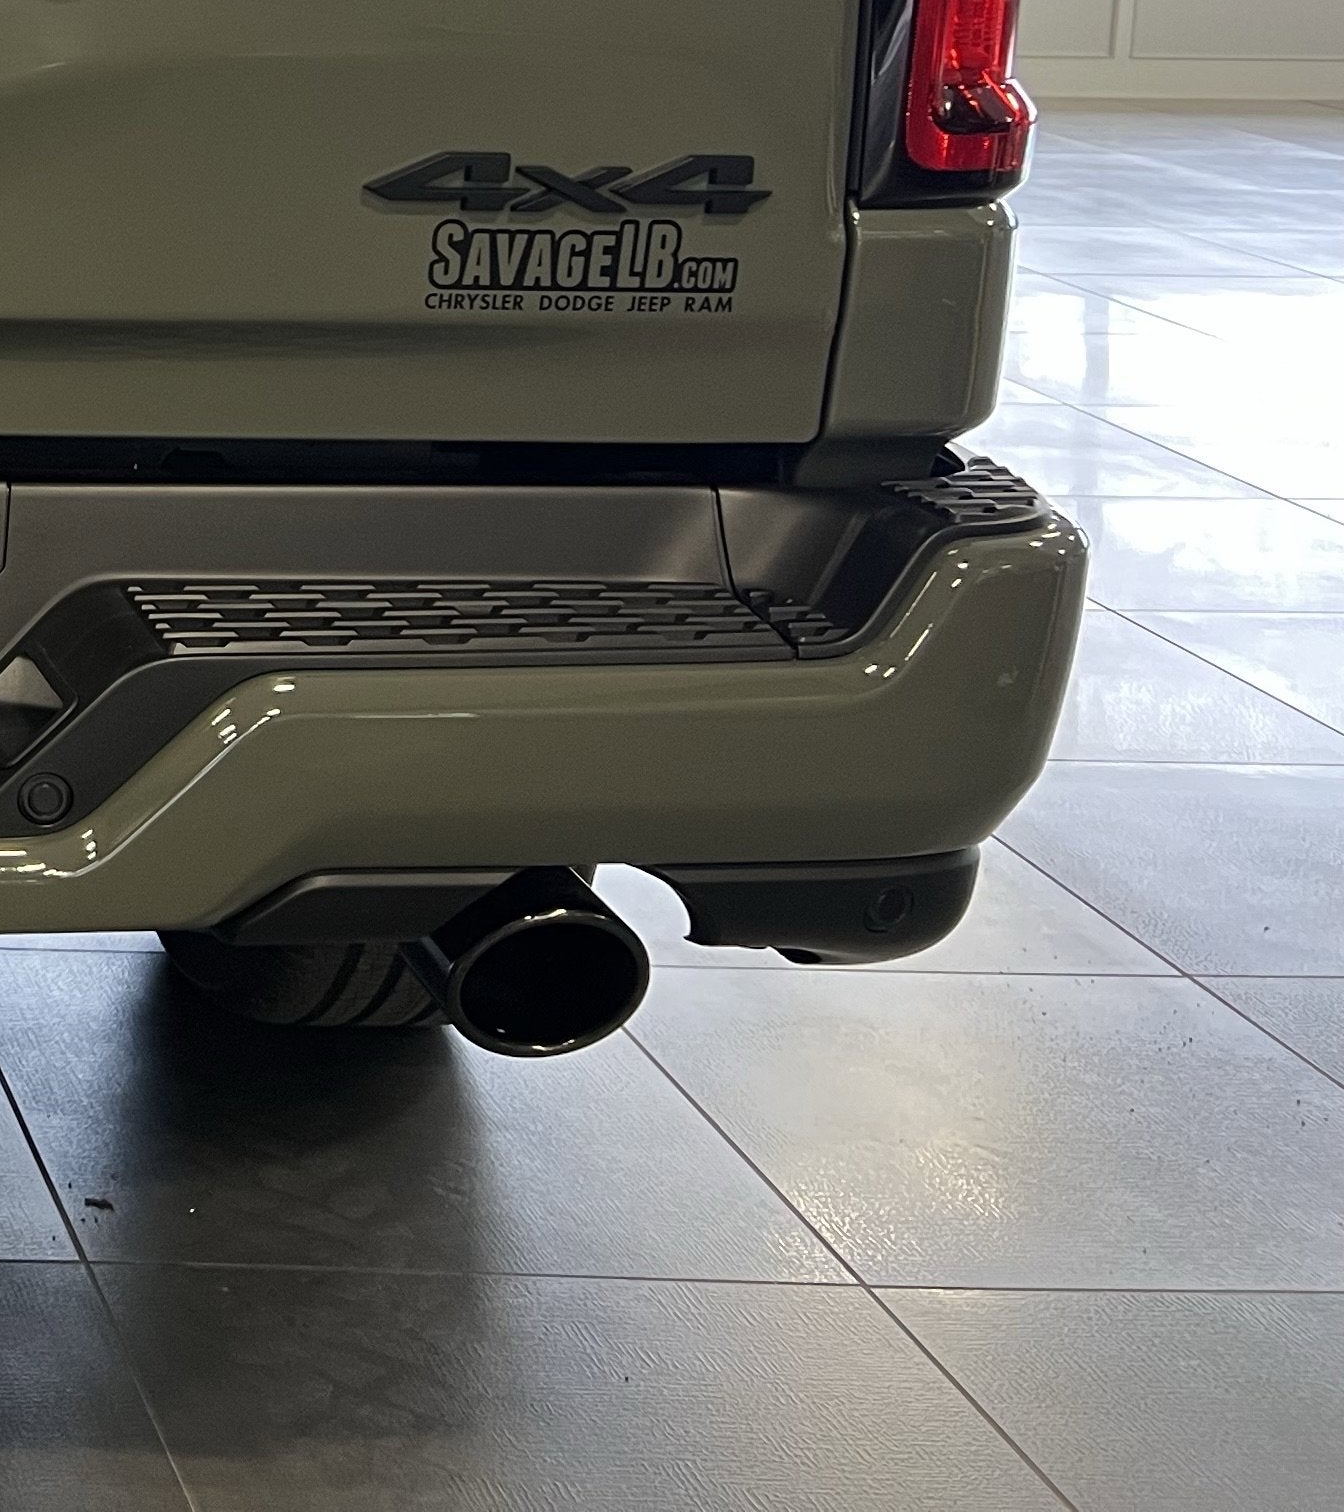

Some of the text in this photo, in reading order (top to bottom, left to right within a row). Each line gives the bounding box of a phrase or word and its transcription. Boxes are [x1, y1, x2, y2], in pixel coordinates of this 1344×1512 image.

[424, 292, 733, 313] CHRYSLER DODGE JEEP RAM
